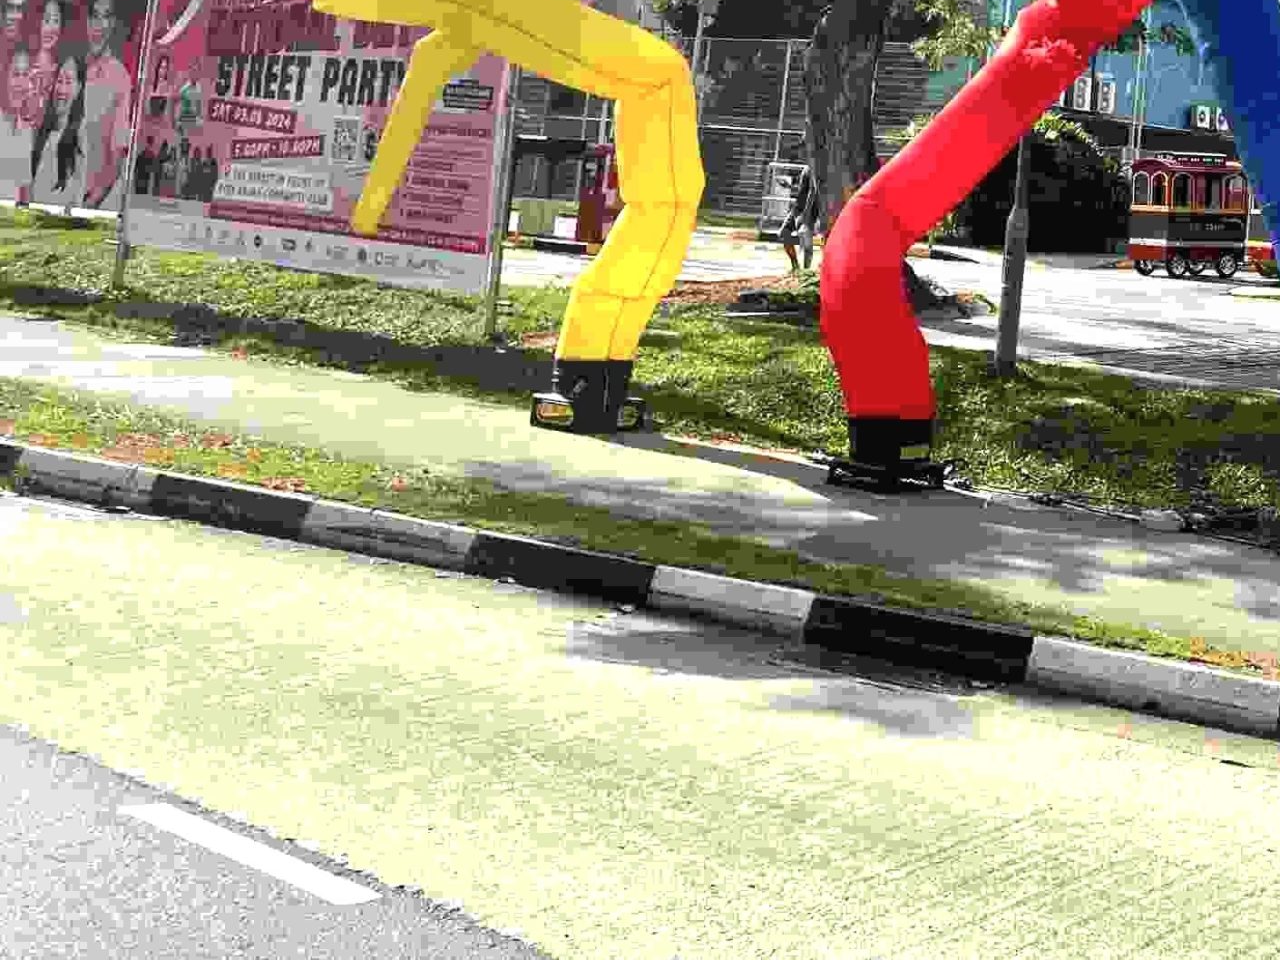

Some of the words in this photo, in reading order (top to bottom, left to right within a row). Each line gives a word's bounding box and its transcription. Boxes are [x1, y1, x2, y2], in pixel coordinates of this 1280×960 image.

[215, 55, 313, 102] STREET
[211, 103, 232, 121] SAT
[265, 111, 291, 130] 2024
